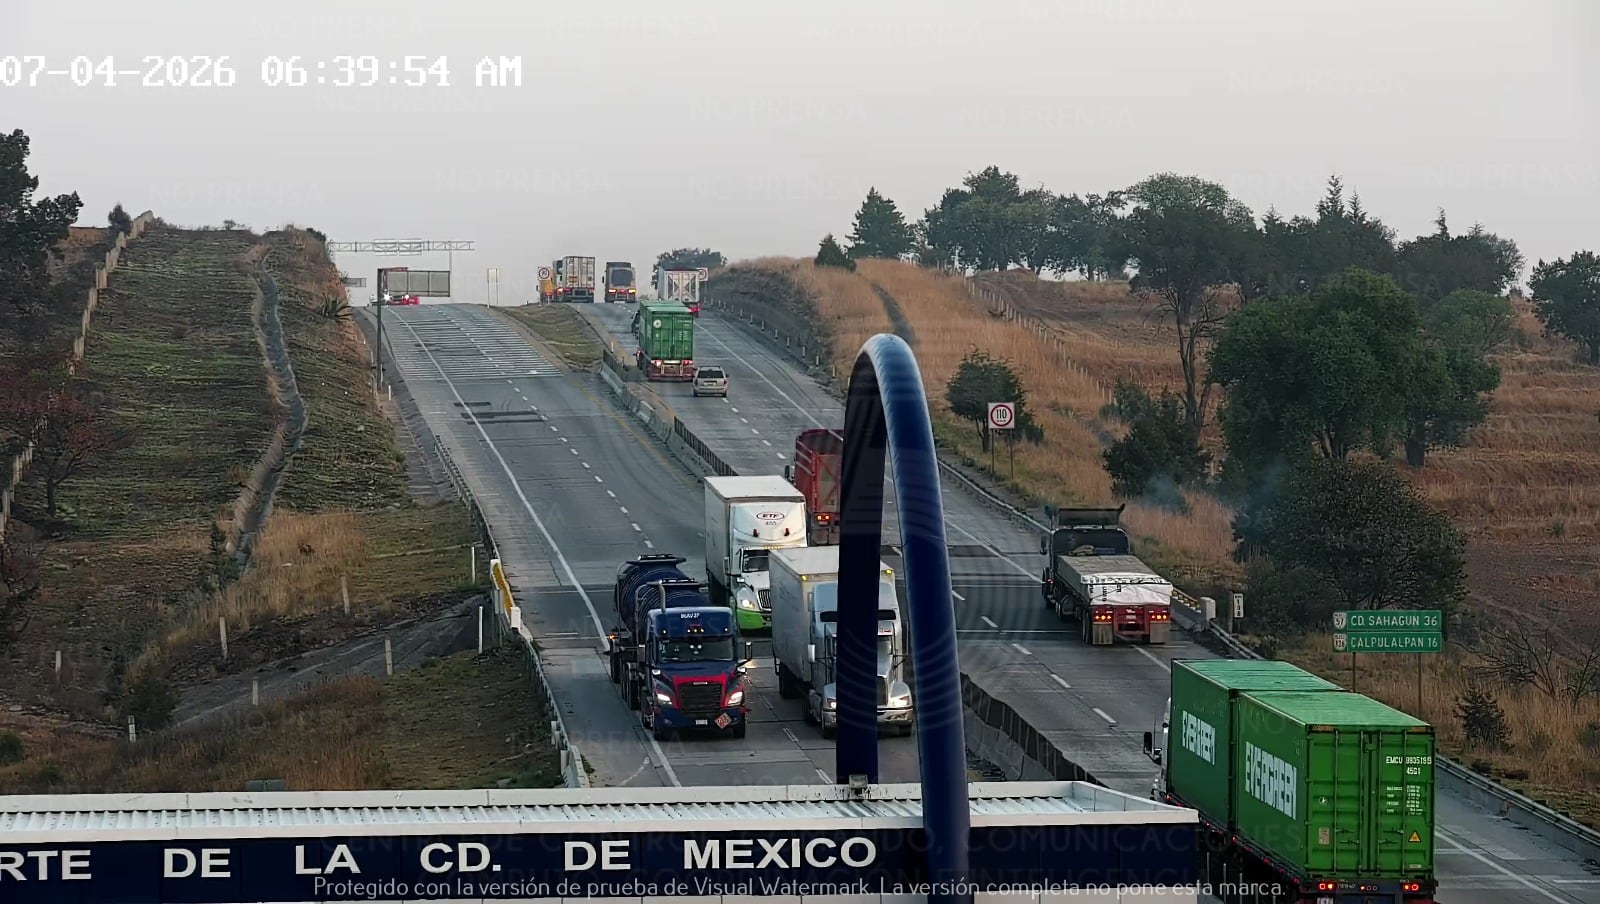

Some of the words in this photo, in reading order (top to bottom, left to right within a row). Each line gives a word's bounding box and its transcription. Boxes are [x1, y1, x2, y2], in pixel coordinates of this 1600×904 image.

[996, 408, 1007, 419] 110
[1368, 615, 1420, 626] SAHAGUN
[1423, 615, 1438, 626] 36
[1350, 637, 1424, 648] CALPULALPAN
[1427, 637, 1438, 648] 16
[1385, 756, 1403, 764] EMCU
[0, 849, 92, 881] RTE
[163, 848, 231, 878] DE
[296, 844, 361, 875] LA
[419, 842, 502, 873] CD.
[564, 840, 631, 871] DE
[682, 837, 877, 870] MEXICO
